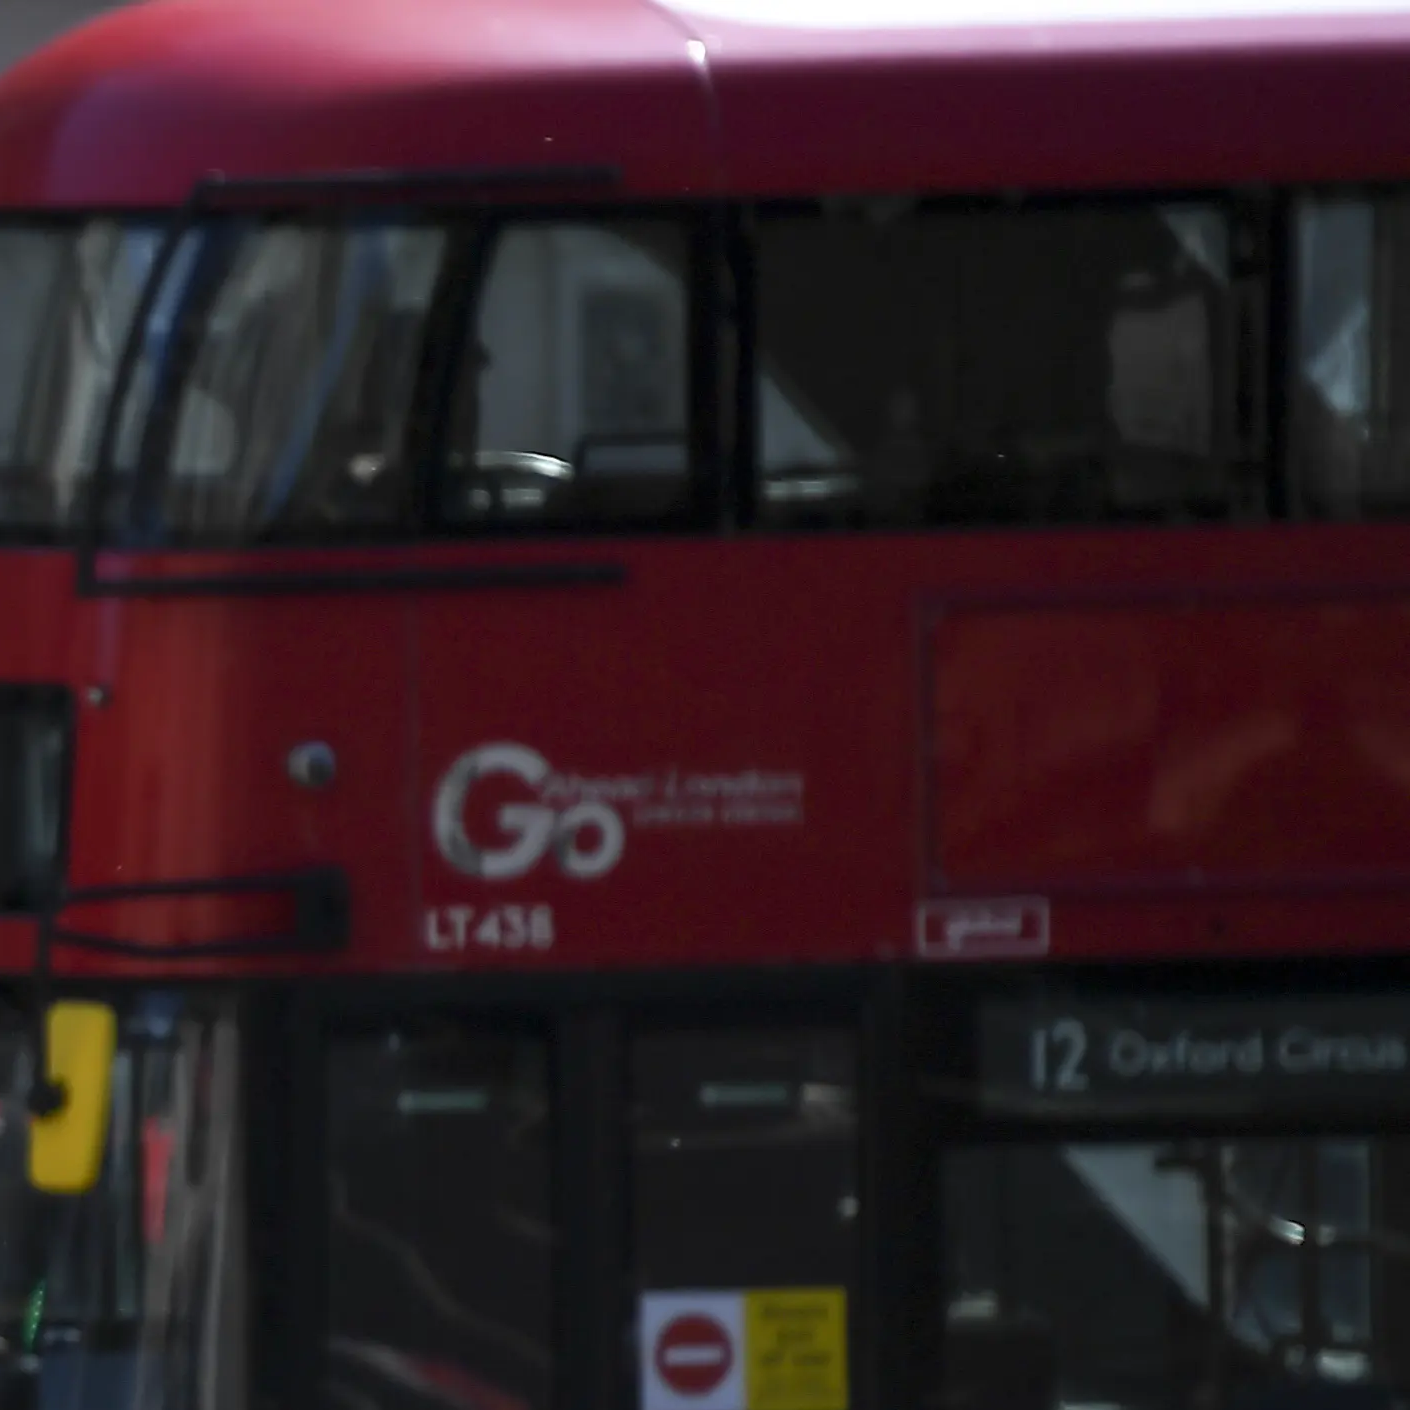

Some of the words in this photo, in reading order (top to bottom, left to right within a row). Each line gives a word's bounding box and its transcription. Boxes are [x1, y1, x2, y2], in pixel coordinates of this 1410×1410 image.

[433, 739, 625, 880] Go
[1029, 1016, 1090, 1091] 12
[1108, 1029, 1264, 1076] Oxford
